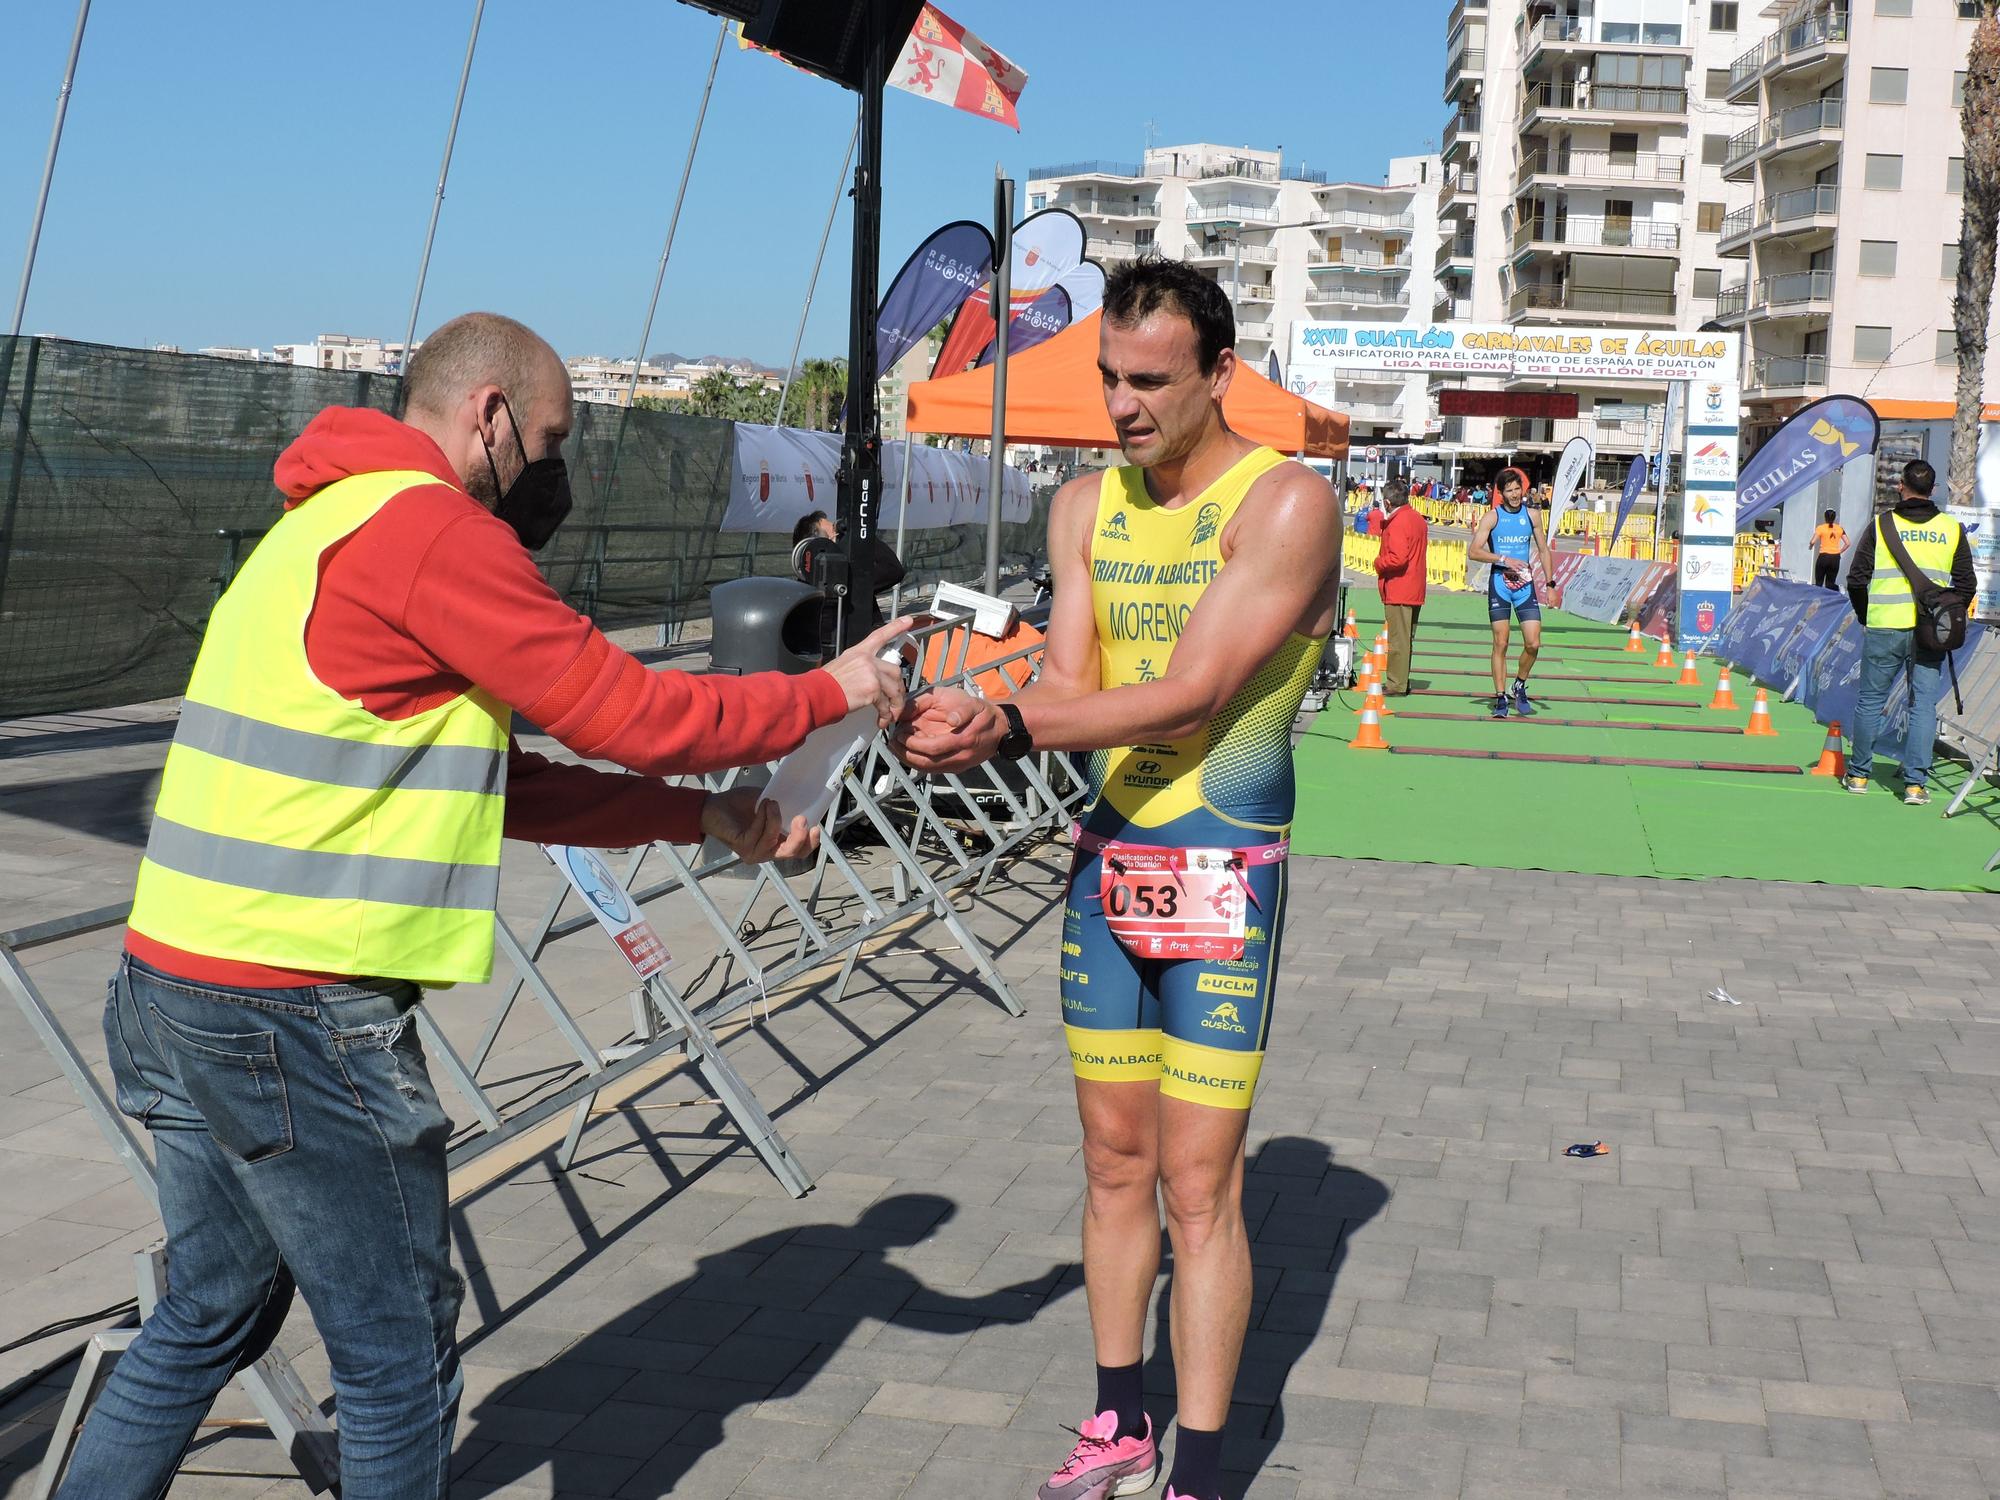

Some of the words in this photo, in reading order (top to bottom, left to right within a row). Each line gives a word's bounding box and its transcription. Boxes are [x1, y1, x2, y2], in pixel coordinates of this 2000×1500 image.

[924, 258, 976, 288] MURCIA
[929, 249, 981, 280] REGIÓN
[1302, 327, 1348, 346] XXVII
[1355, 326, 1454, 349] DUATLÓN
[1462, 331, 1592, 353] CARNAVALES
[1600, 337, 1628, 355] DE
[1635, 332, 1727, 358] ÁGUILAS
[1313, 348, 1415, 359] CLASIFICATORIO
[1417, 351, 1450, 360] PARA
[1454, 352, 1467, 360] EL
[1472, 352, 1560, 364] CAMPEONATO
[1564, 356, 1580, 364] DE
[1584, 355, 1633, 367] ESPAÑA
[1637, 359, 1653, 367] DE
[1657, 358, 1716, 369] DUATLÓN
[1383, 360, 1422, 368] LIGA
[1429, 361, 1524, 372] REGIONAL
[1528, 365, 1551, 373] DE
[1558, 366, 1644, 376] DUATLÓN
[1652, 369, 1698, 378] 2021
[1736, 448, 1817, 509] GUILAS
[1092, 559, 1155, 584] TRIATLÓN
[1155, 560, 1217, 585] ALBACETE
[1109, 884, 1178, 918] 053
[1201, 1018, 1247, 1033] austral
[1172, 1066, 1246, 1090] ALBACETE
